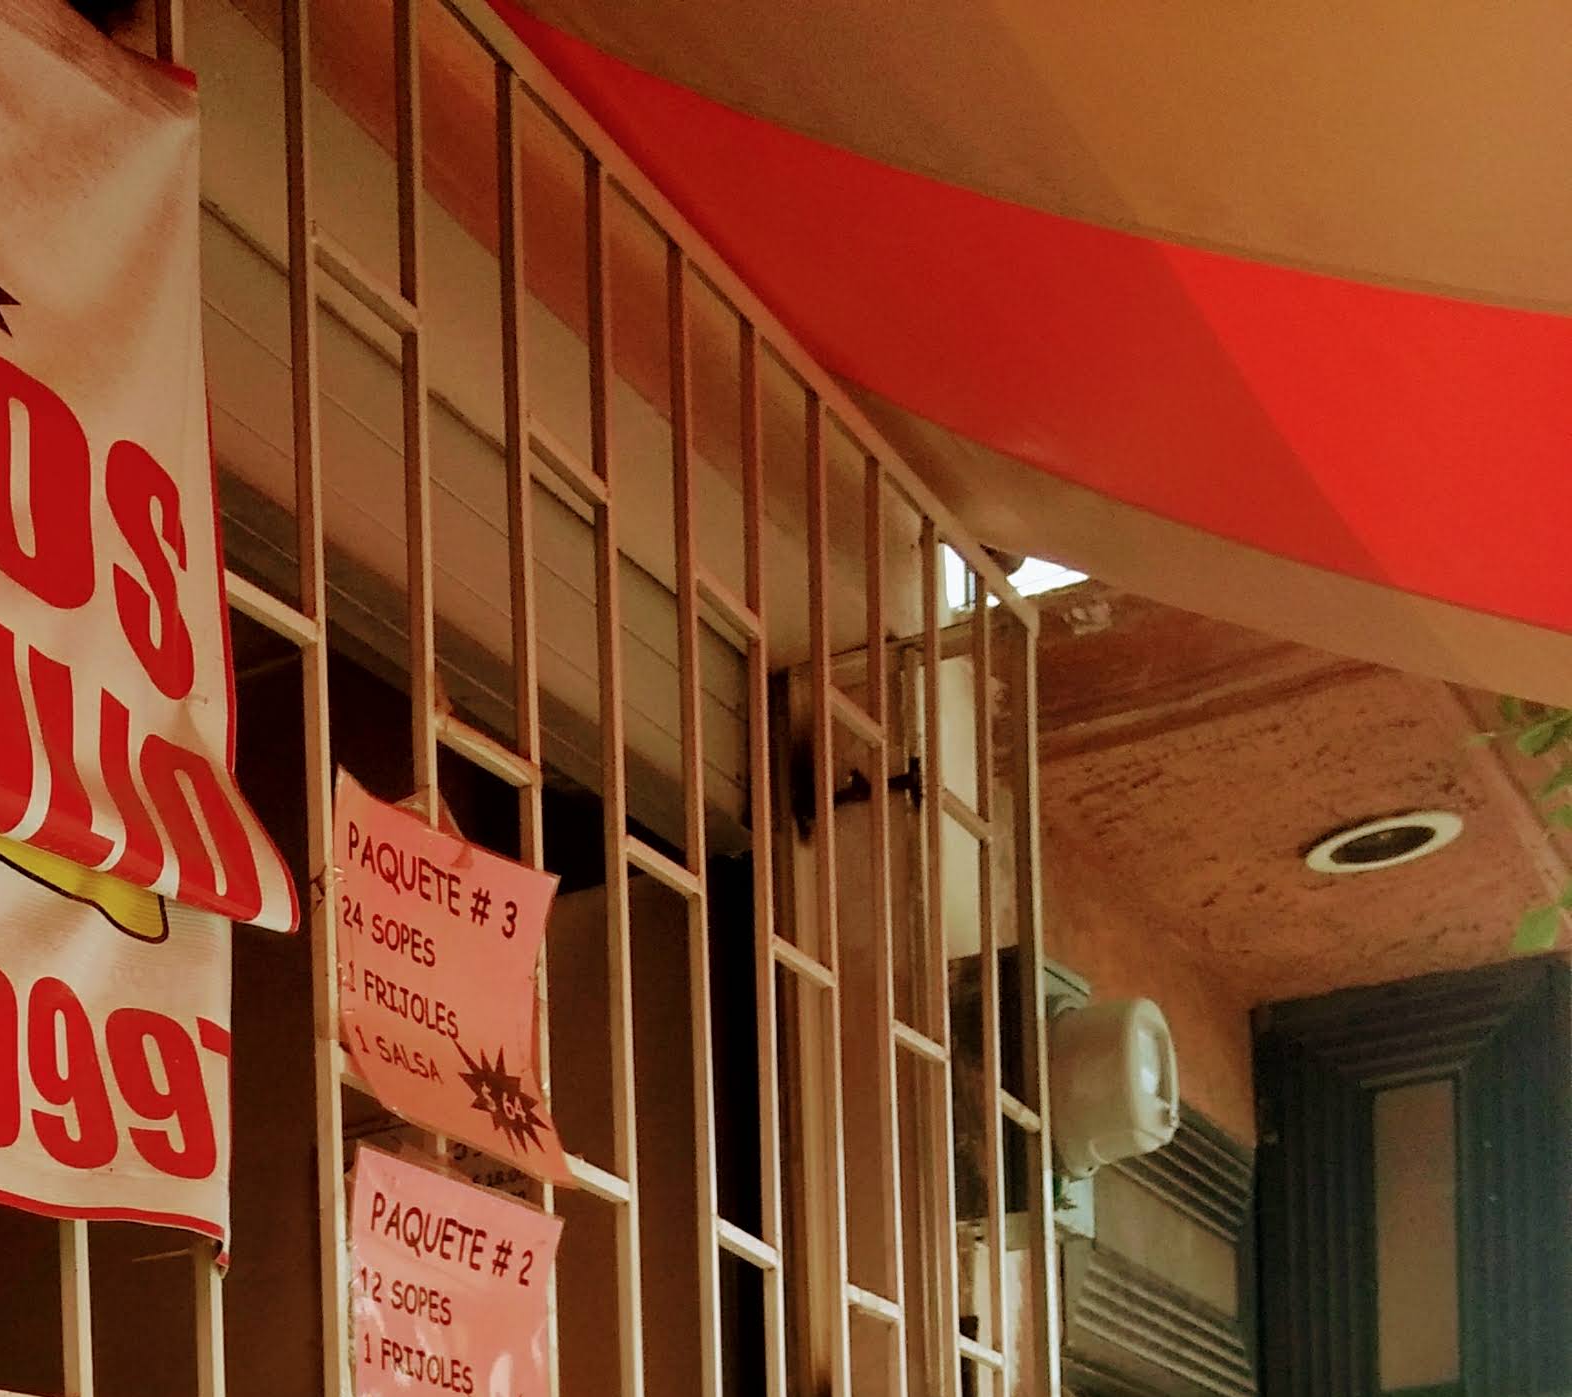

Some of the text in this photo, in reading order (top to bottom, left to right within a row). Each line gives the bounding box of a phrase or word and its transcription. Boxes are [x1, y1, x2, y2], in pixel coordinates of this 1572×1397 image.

[348, 820, 518, 939] PAQUETE # 3
[341, 894, 436, 968] 24 SOPES
[363, 969, 459, 1040] FRIJOLES
[354, 1024, 445, 1085] 1 SALSA
[369, 1191, 534, 1288] PAQUETE # 2
[360, 1266, 452, 1327] 12 SOPES
[363, 1332, 474, 1395] 1 FRIJOLES
